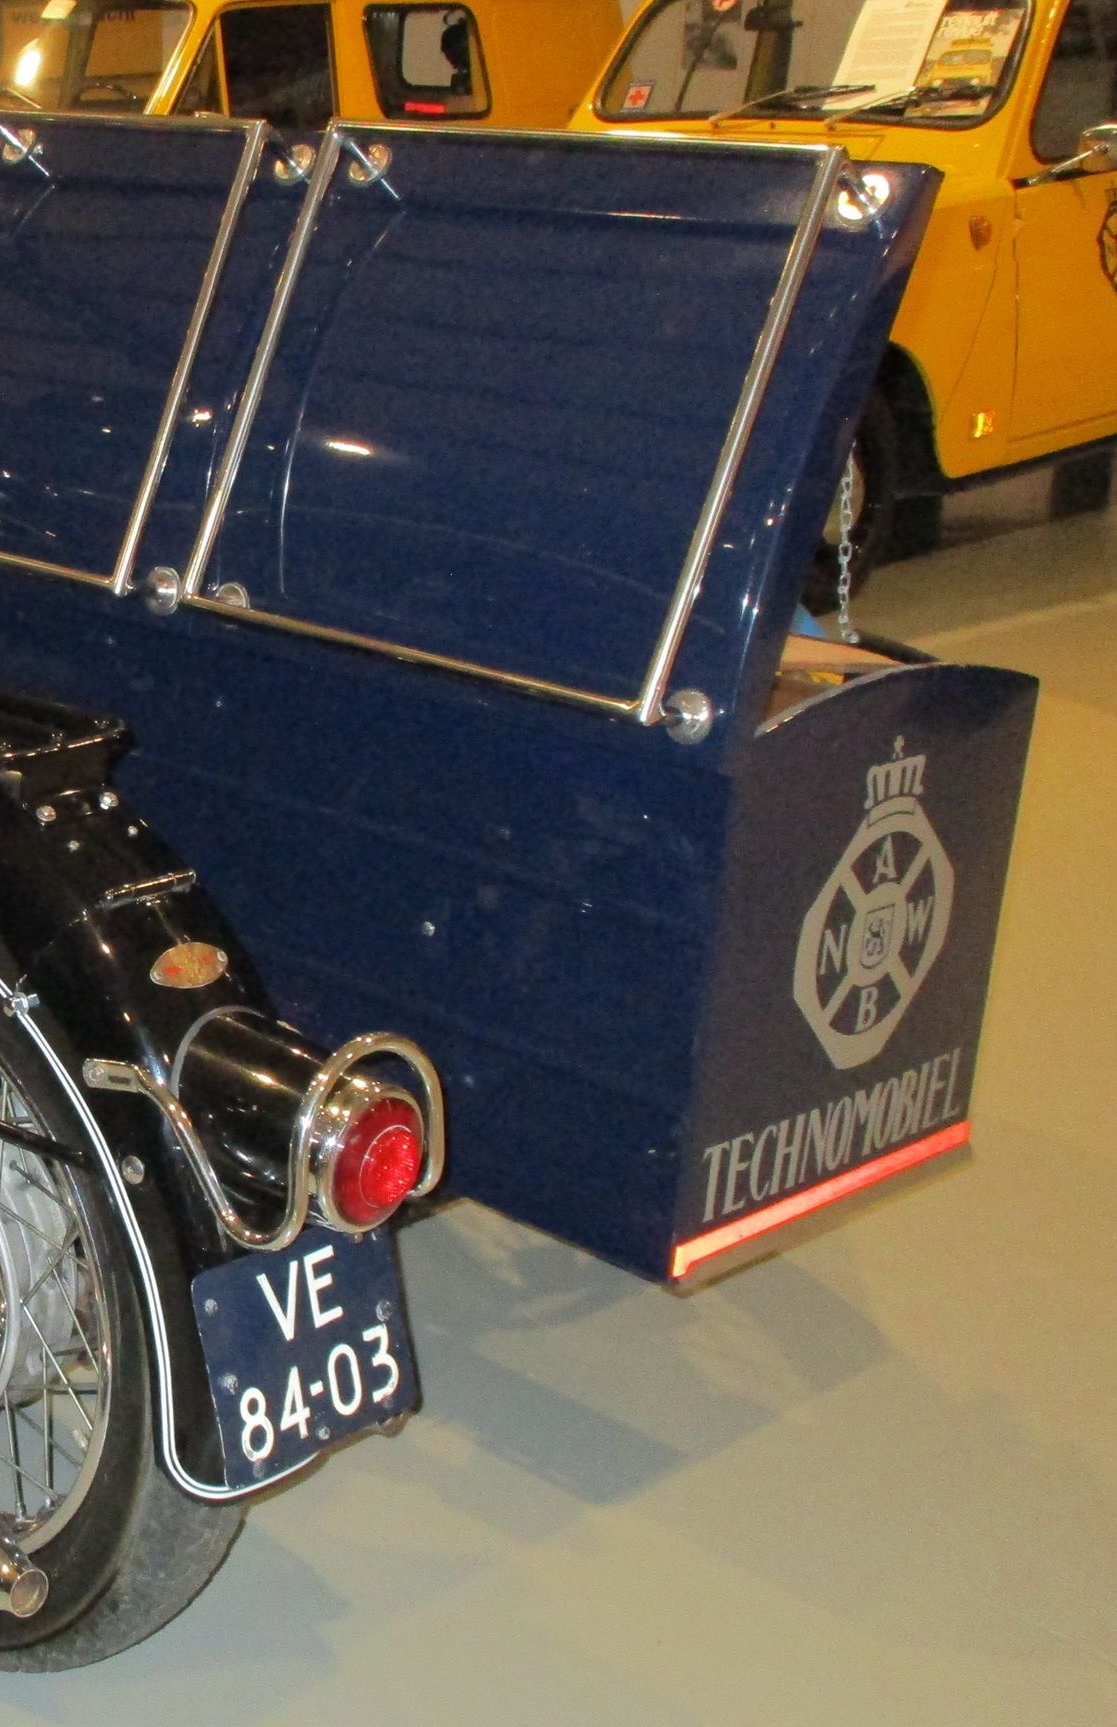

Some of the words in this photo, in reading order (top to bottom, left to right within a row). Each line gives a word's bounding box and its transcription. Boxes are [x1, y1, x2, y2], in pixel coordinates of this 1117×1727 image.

[873, 835, 898, 885] A
[819, 924, 847, 975] N
[907, 895, 934, 945] W
[855, 986, 879, 1033] B
[702, 1048, 961, 1222] TECHNOMOBIEL
[258, 1245, 343, 1341] VE
[240, 1324, 398, 1461] 84-03
